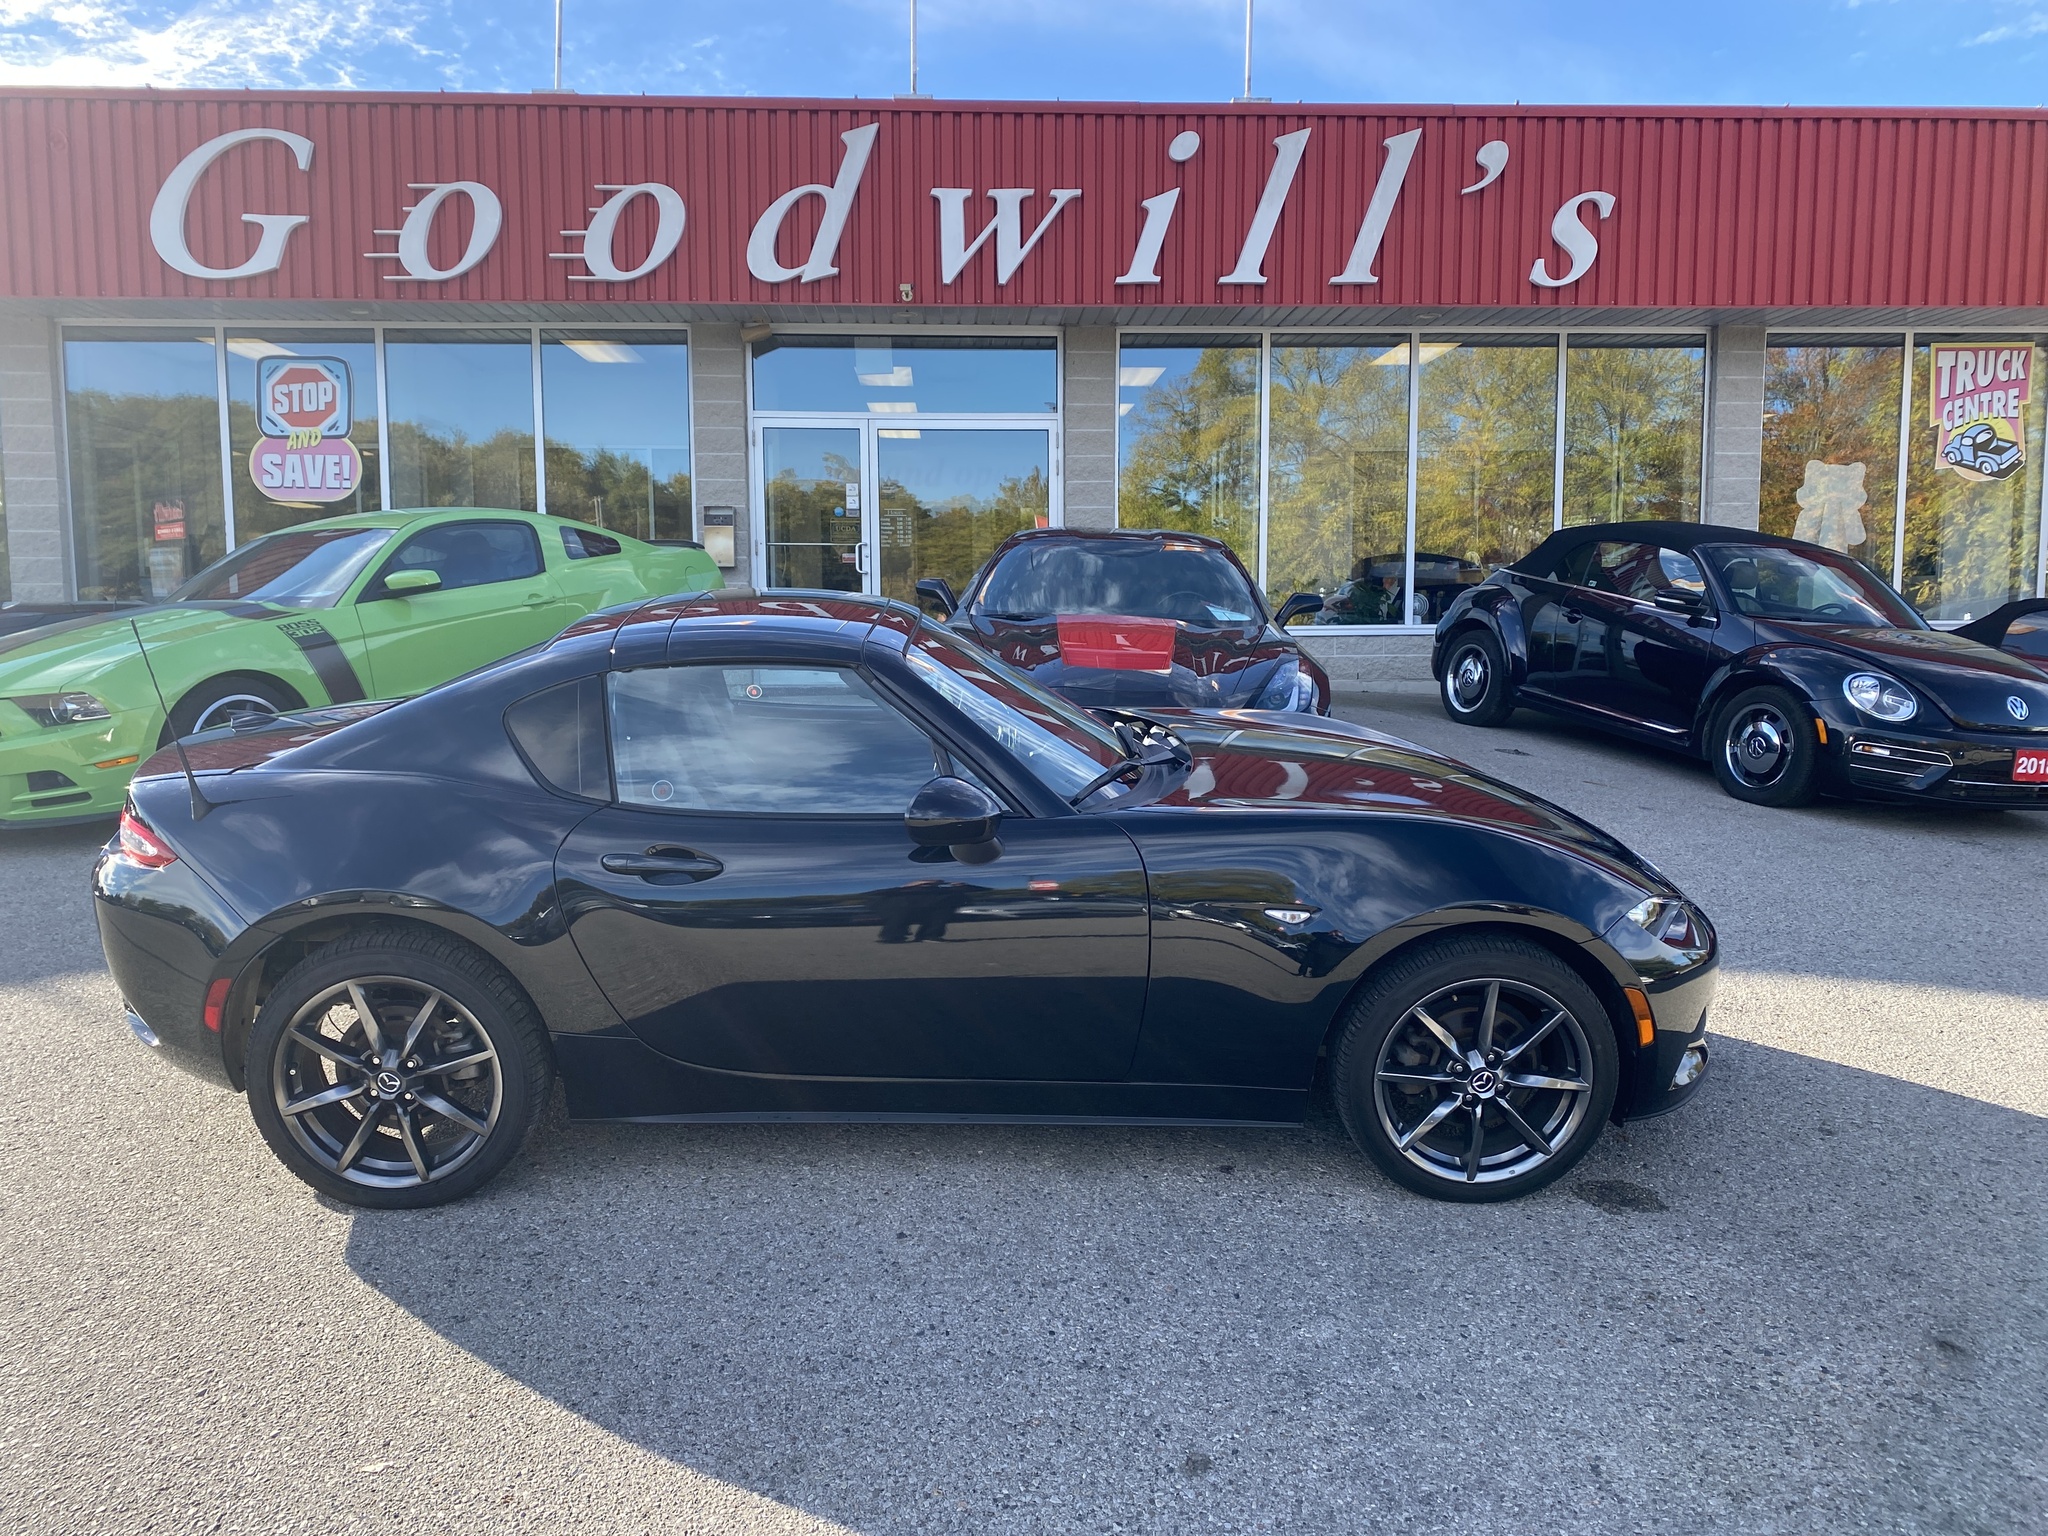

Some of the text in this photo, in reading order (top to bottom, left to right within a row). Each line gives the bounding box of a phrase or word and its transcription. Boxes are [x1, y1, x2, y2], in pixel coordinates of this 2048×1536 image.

[149, 122, 1617, 288] Goodwill's
[1937, 349, 2028, 399] TRUCK
[273, 381, 333, 414] STOP
[1942, 387, 2020, 432] CENTRE
[287, 427, 322, 451] AND
[261, 453, 352, 490] SAVE!
[276, 618, 321, 632] BOSS
[288, 626, 325, 638] 302
[2016, 756, 2048, 775] 201
